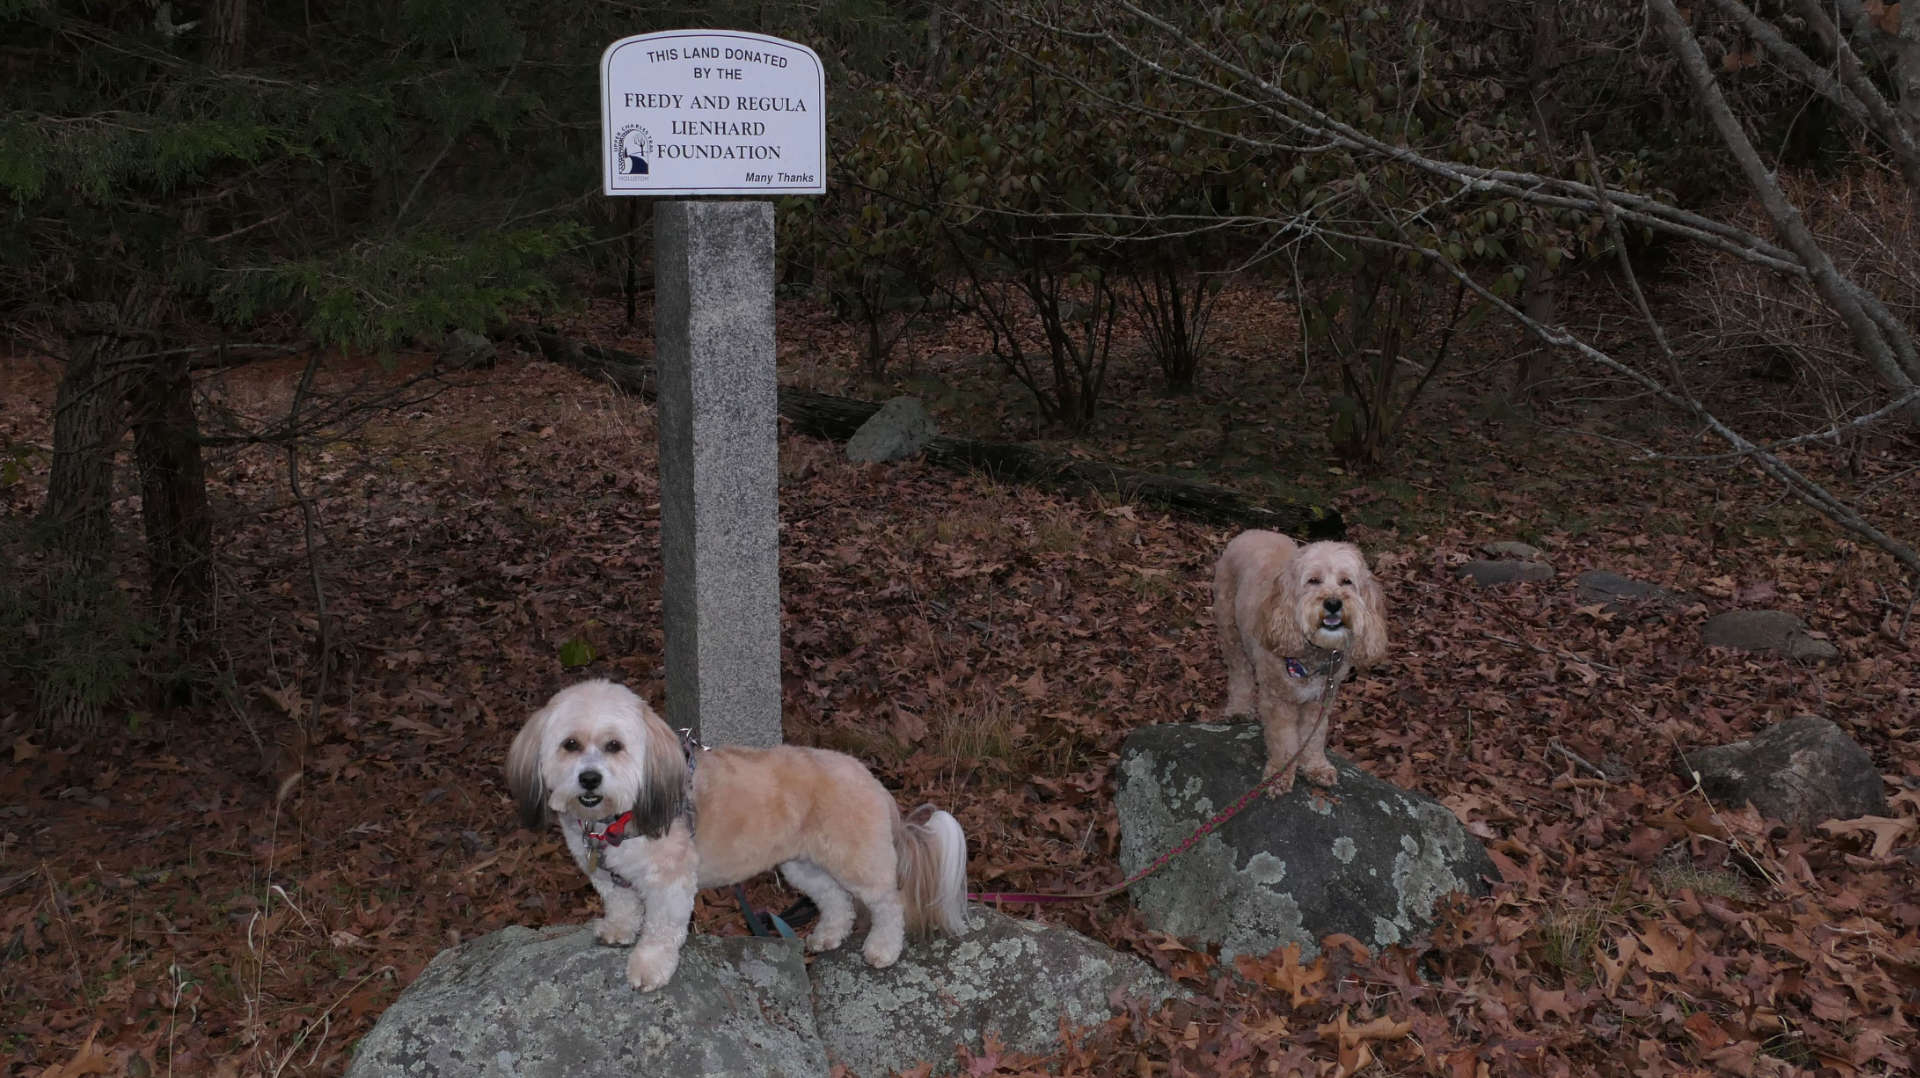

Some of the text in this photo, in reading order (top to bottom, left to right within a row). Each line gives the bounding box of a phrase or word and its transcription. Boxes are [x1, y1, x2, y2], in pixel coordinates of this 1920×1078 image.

[647, 47, 788, 69] THIS LAND DONATED
[694, 68, 742, 80] BY THE
[624, 92, 807, 112] FREDY AND REGULA
[671, 120, 765, 136] LIENHARD
[657, 144, 781, 160] FOUNDATION
[745, 172, 814, 184] Many Thanks
